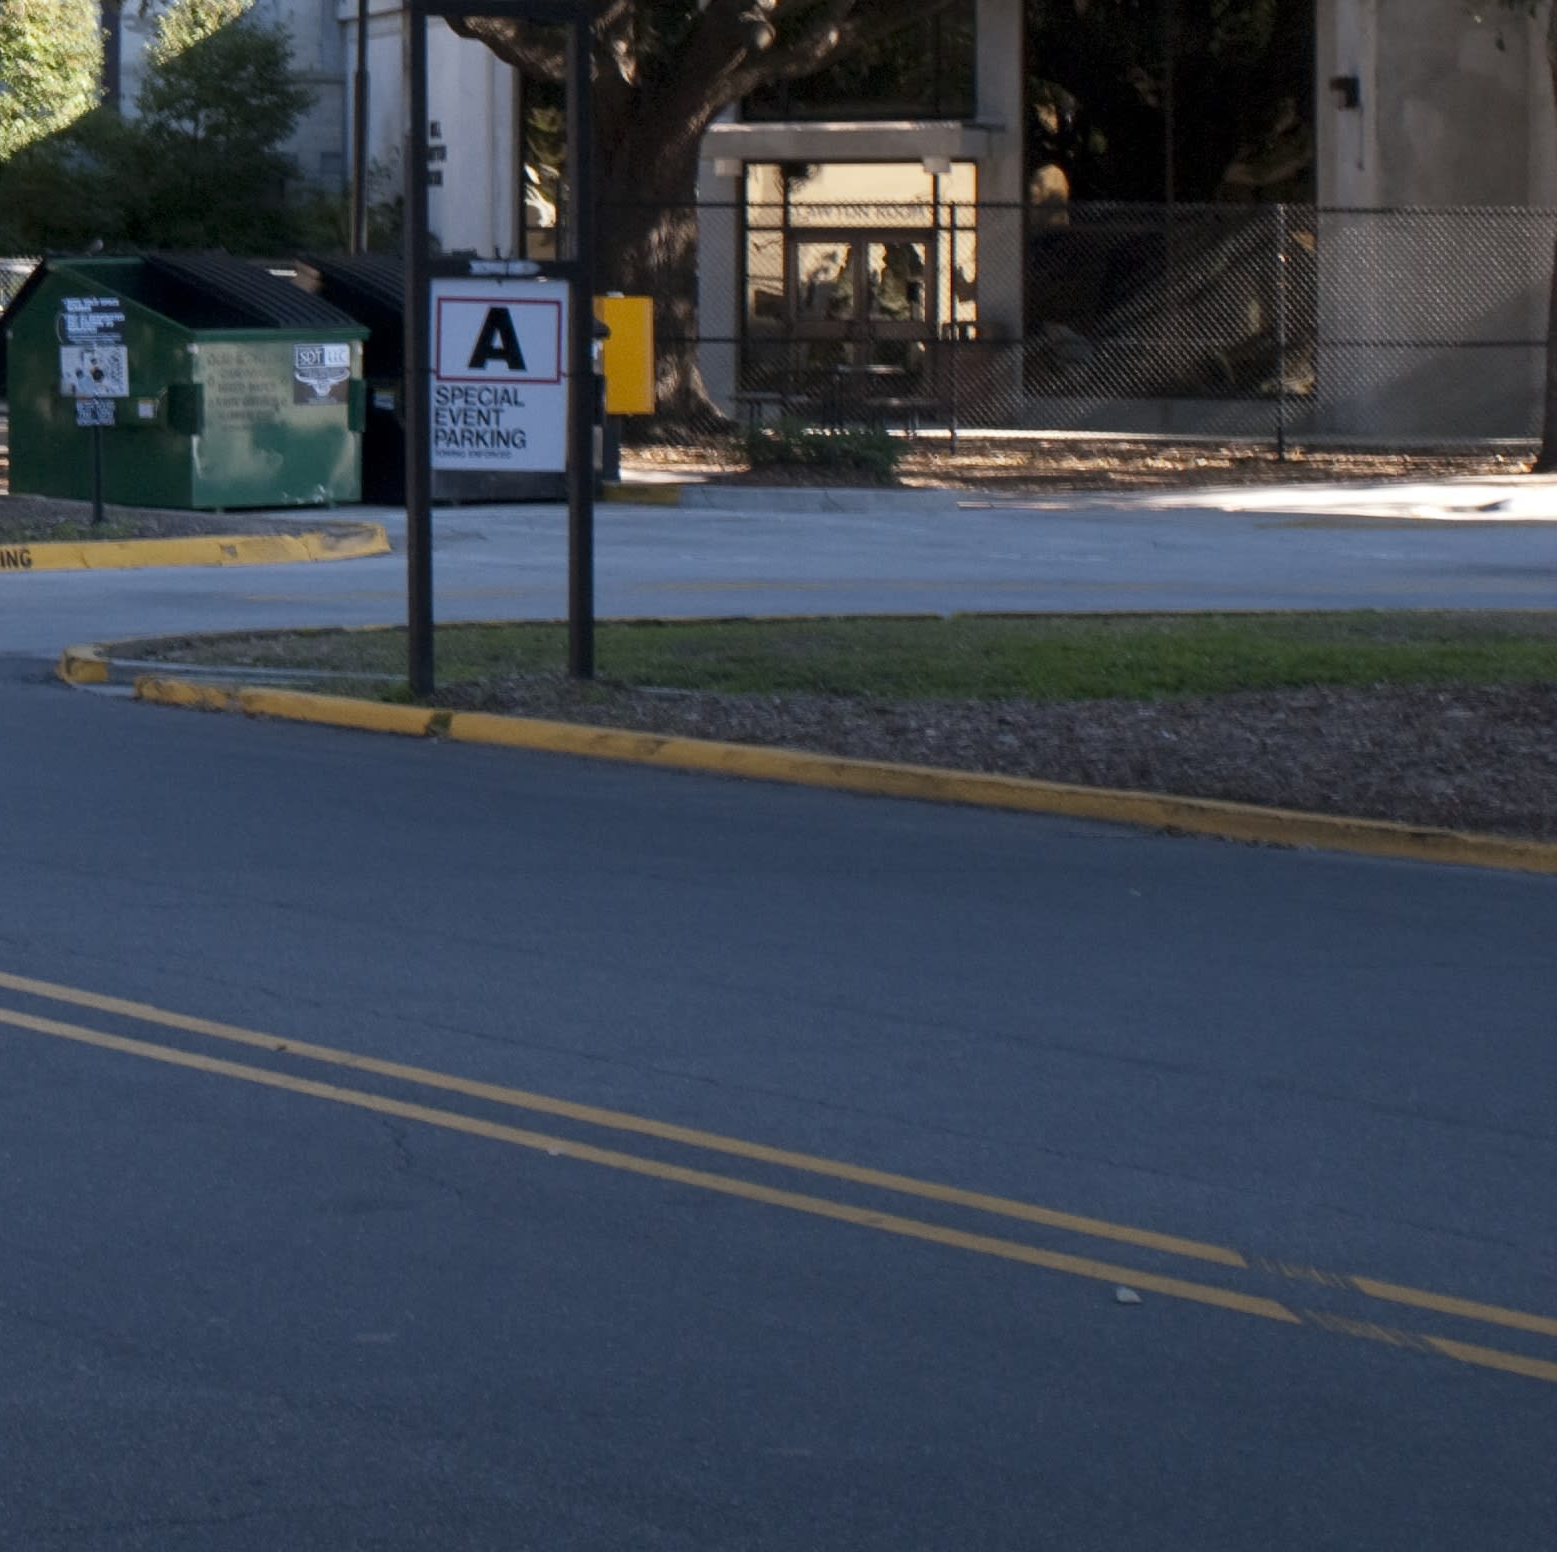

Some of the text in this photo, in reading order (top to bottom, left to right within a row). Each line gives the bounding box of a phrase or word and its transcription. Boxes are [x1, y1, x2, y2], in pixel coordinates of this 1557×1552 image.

[467, 305, 527, 372] A
[435, 384, 525, 408] SPECIAL
[435, 407, 505, 427] EVENT
[435, 428, 527, 450] PARKING
